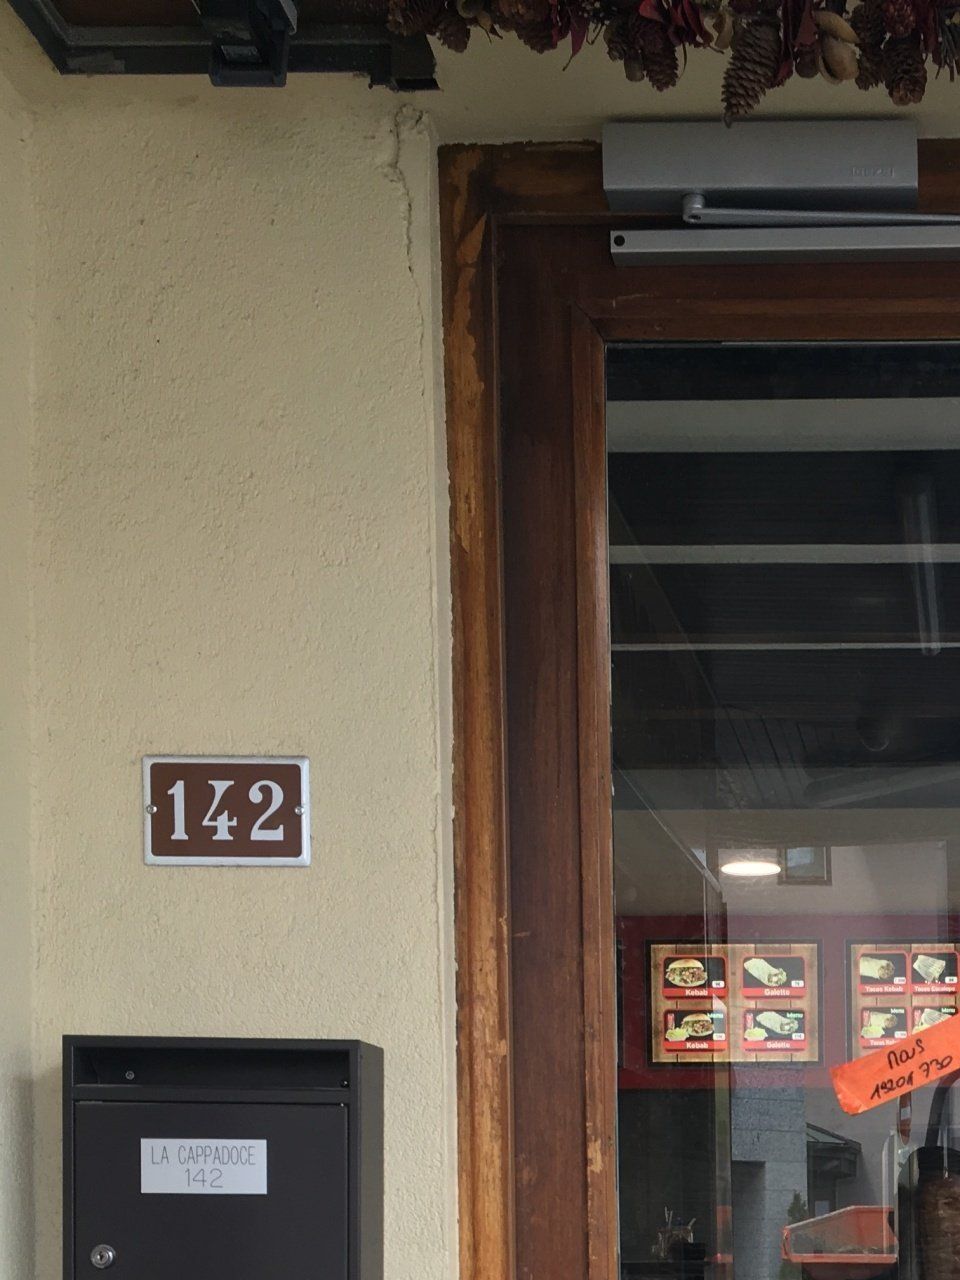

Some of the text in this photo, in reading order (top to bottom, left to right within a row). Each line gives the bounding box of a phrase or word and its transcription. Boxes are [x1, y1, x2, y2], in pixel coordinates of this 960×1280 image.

[166, 780, 285, 841] 142
[685, 988, 709, 996] Kebab
[151, 1145, 256, 1165] LA CAPPADOCE
[184, 1168, 223, 1188] 142
